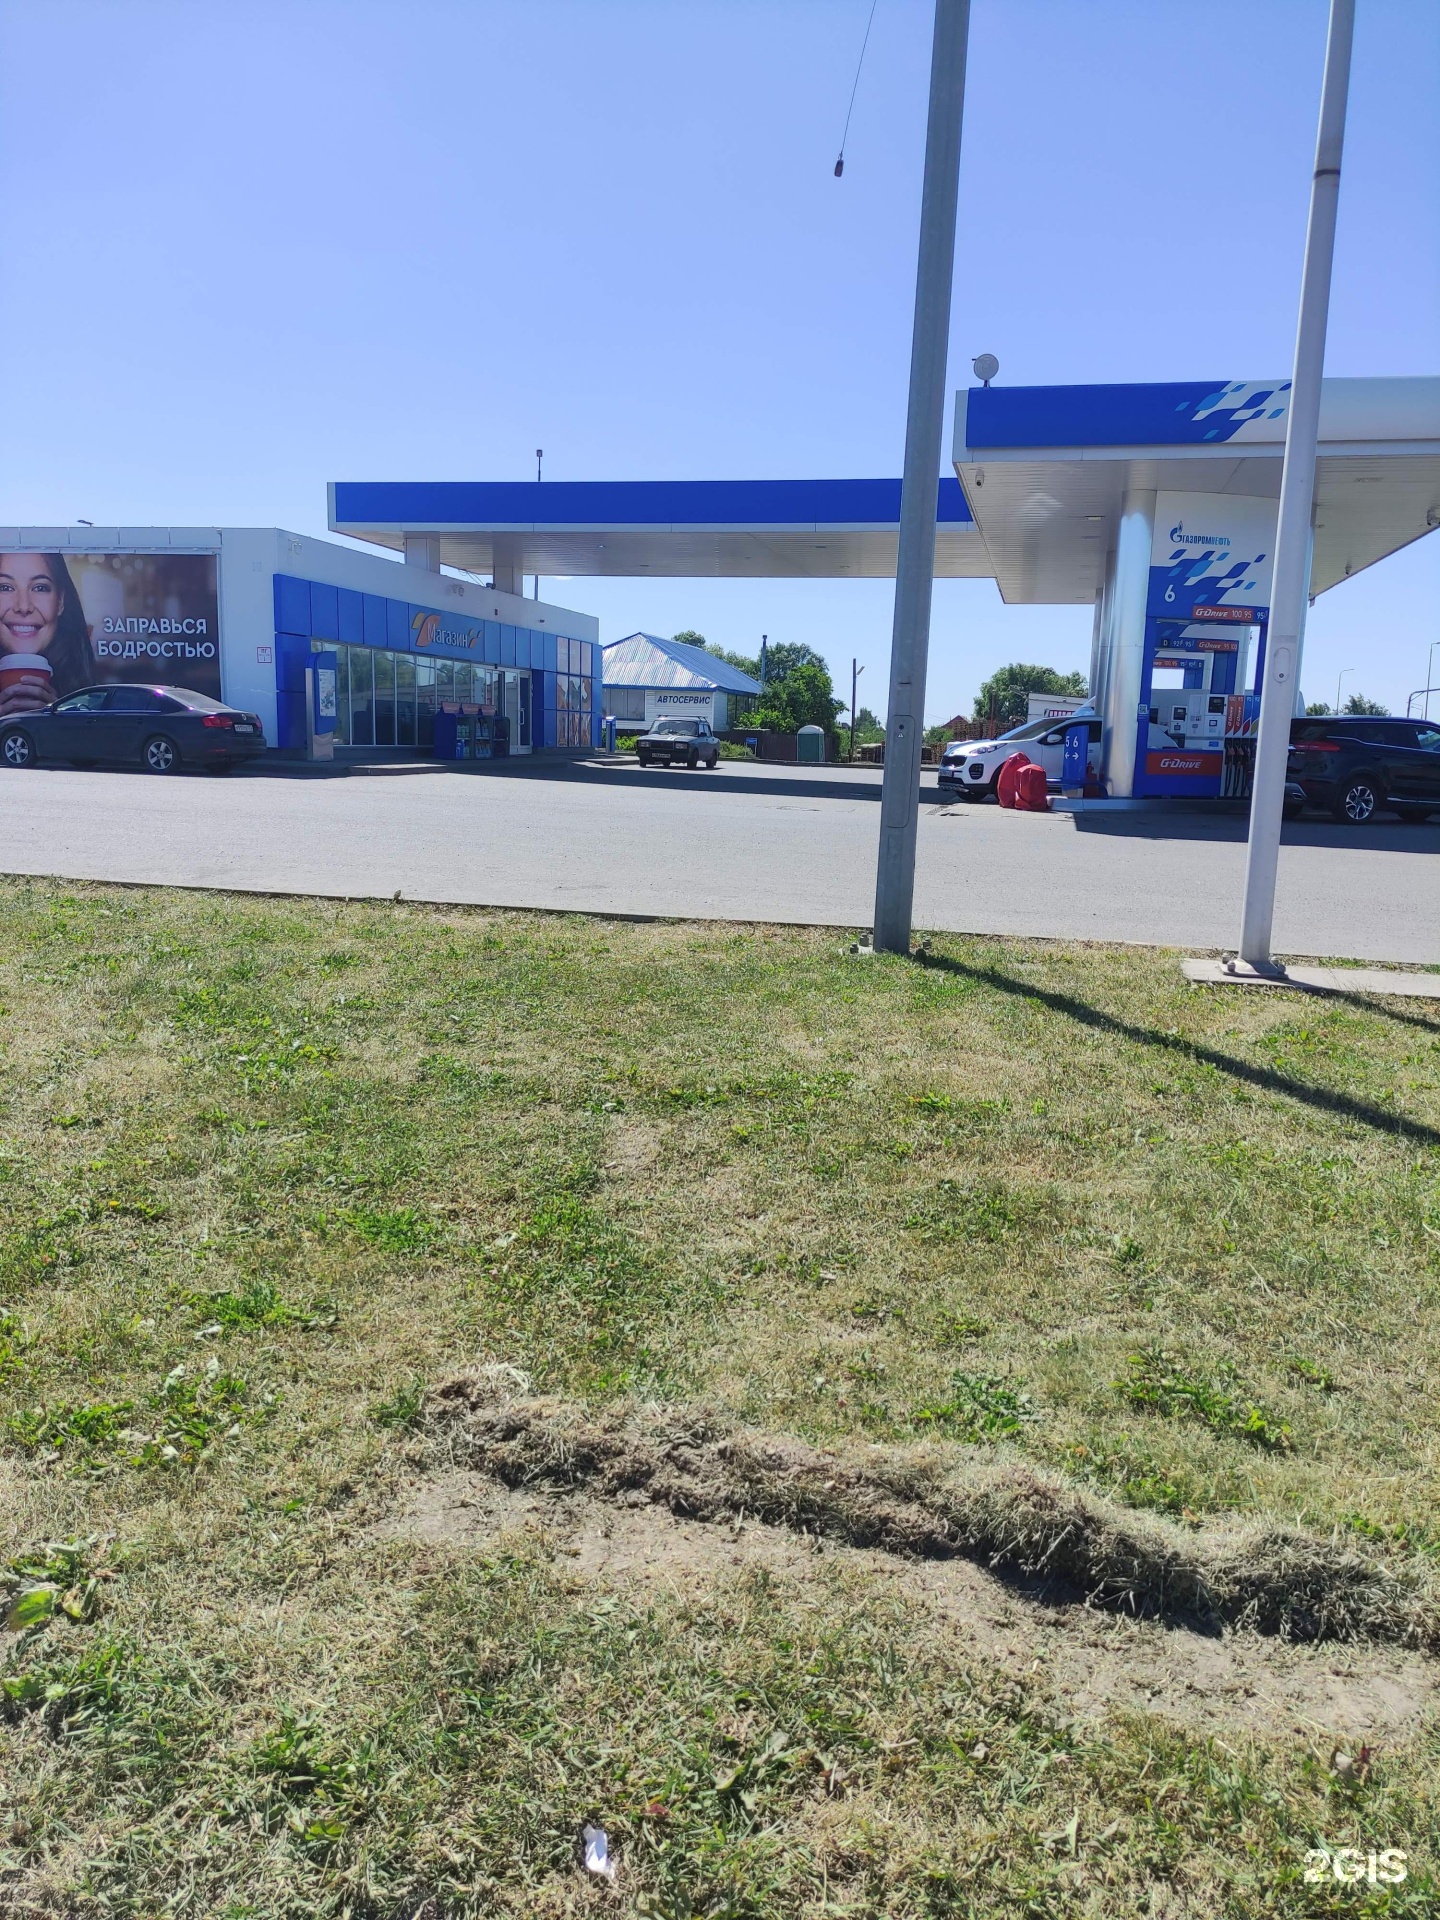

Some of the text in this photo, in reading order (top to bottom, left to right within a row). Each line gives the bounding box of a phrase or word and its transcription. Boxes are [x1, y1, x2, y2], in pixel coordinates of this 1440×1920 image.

[1164, 584, 1176, 603] 6
[1232, 609, 1243, 618] 100
[1244, 610, 1252, 619] 95
[1256, 611, 1264, 620] 95
[103, 617, 207, 634] ЗАПРАВЬСЯ
[427, 622, 468, 648] Магазин
[97, 640, 216, 660] БОДРОСТЬЮ
[656, 695, 711, 705] АВТОСЕРВИС
[1065, 736, 1079, 748] 5 6
